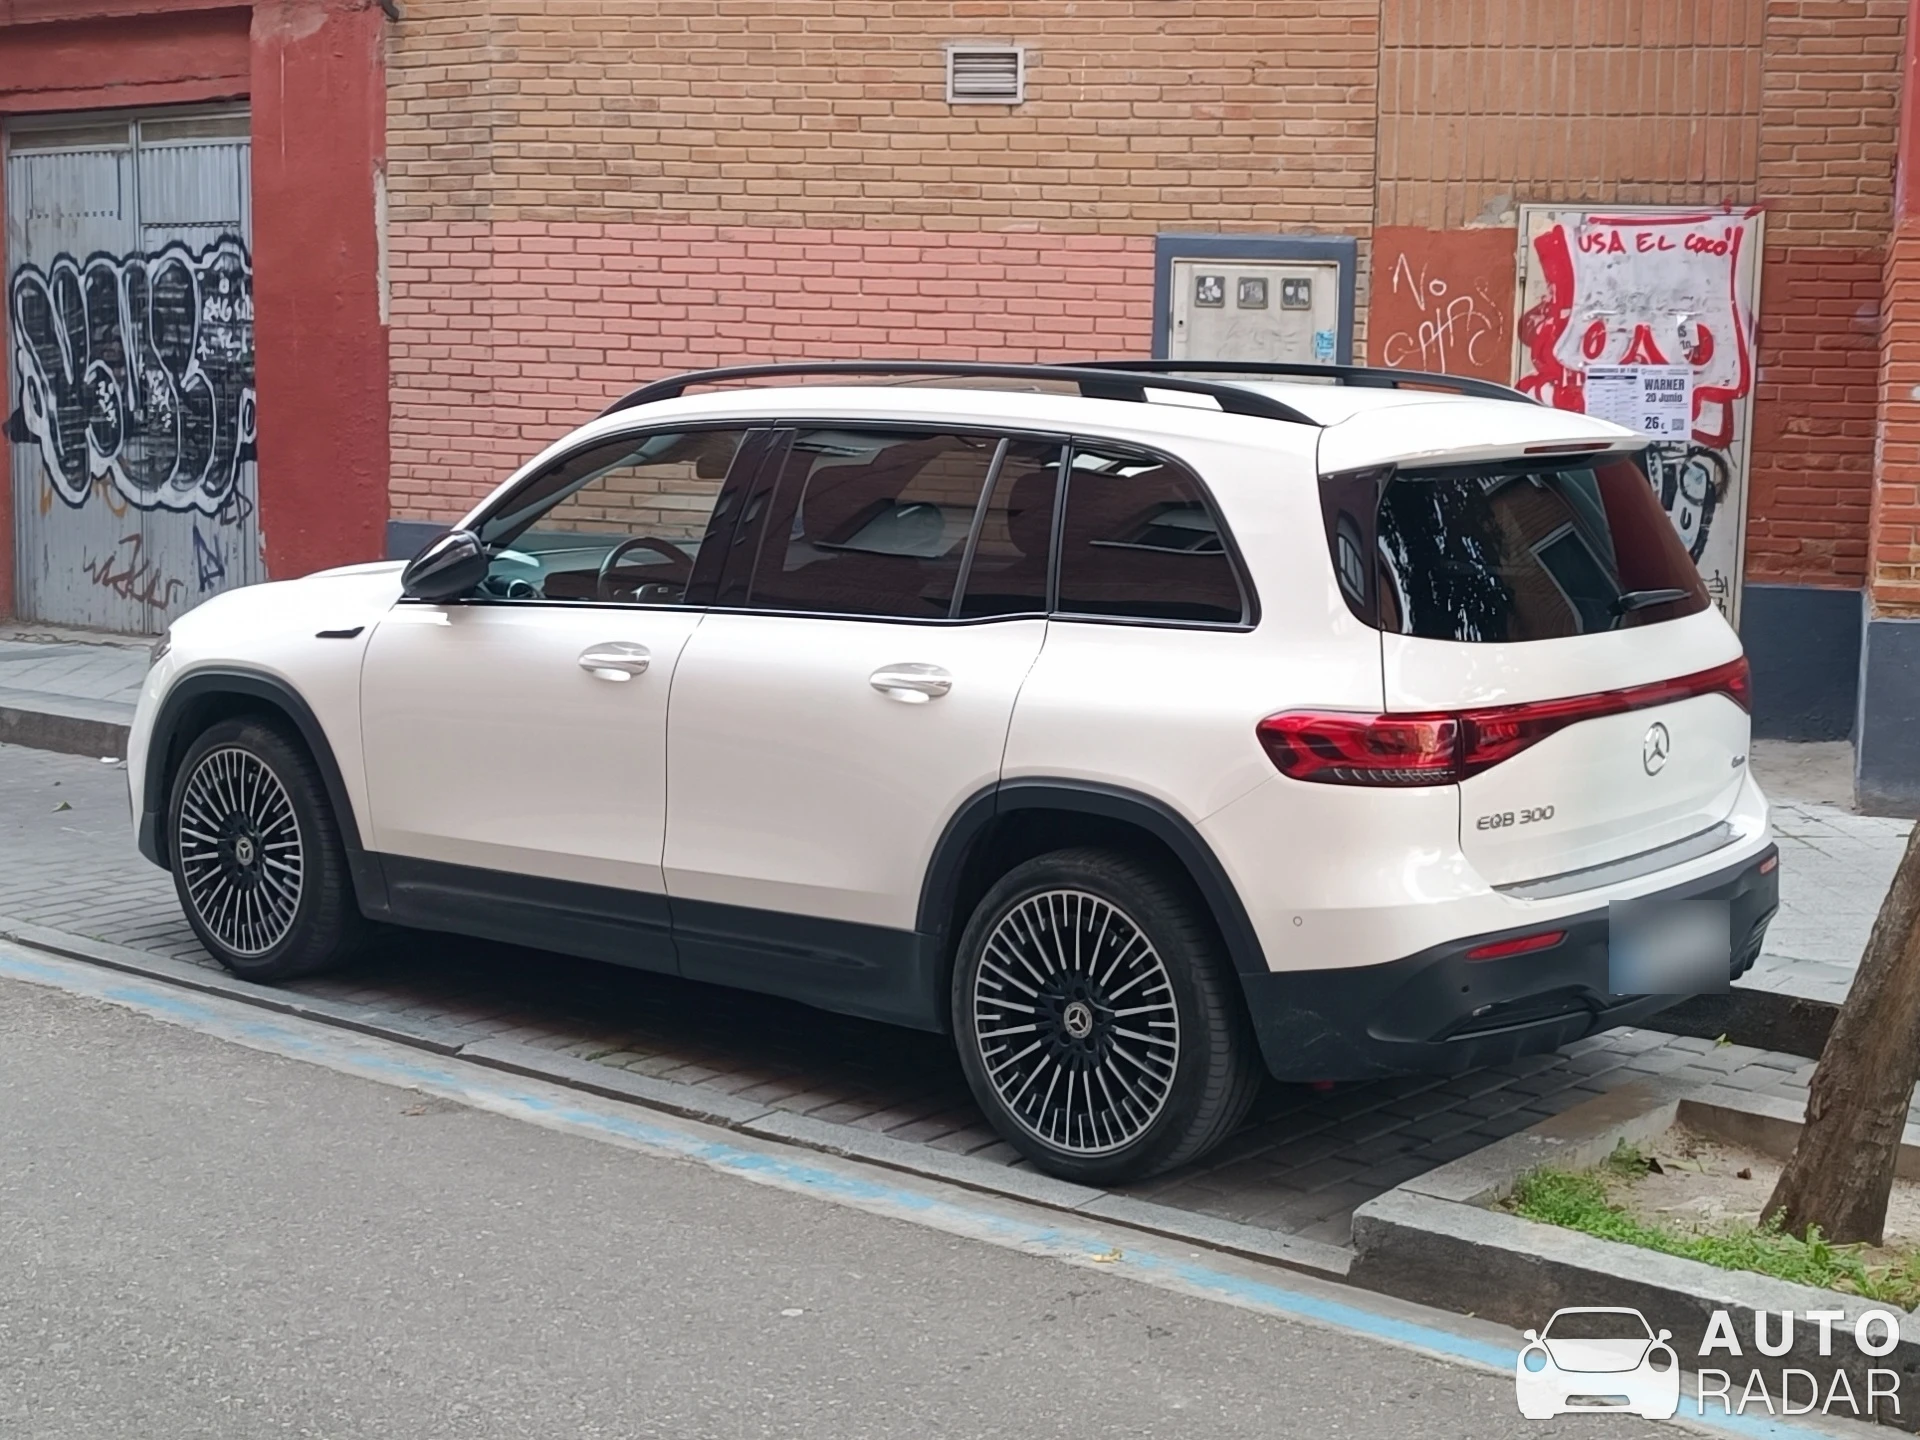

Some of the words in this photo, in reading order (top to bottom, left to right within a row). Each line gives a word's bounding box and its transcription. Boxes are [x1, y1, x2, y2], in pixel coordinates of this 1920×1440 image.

[1578, 230, 1626, 254] USA
[1636, 233, 1676, 253] EL
[1644, 379, 1685, 391] WARNER
[1645, 393, 1656, 403] 20
[1659, 392, 1682, 403] Junio
[1645, 416, 1659, 430] 26
[1476, 811, 1515, 831] EQB
[1519, 805, 1555, 825] 300
